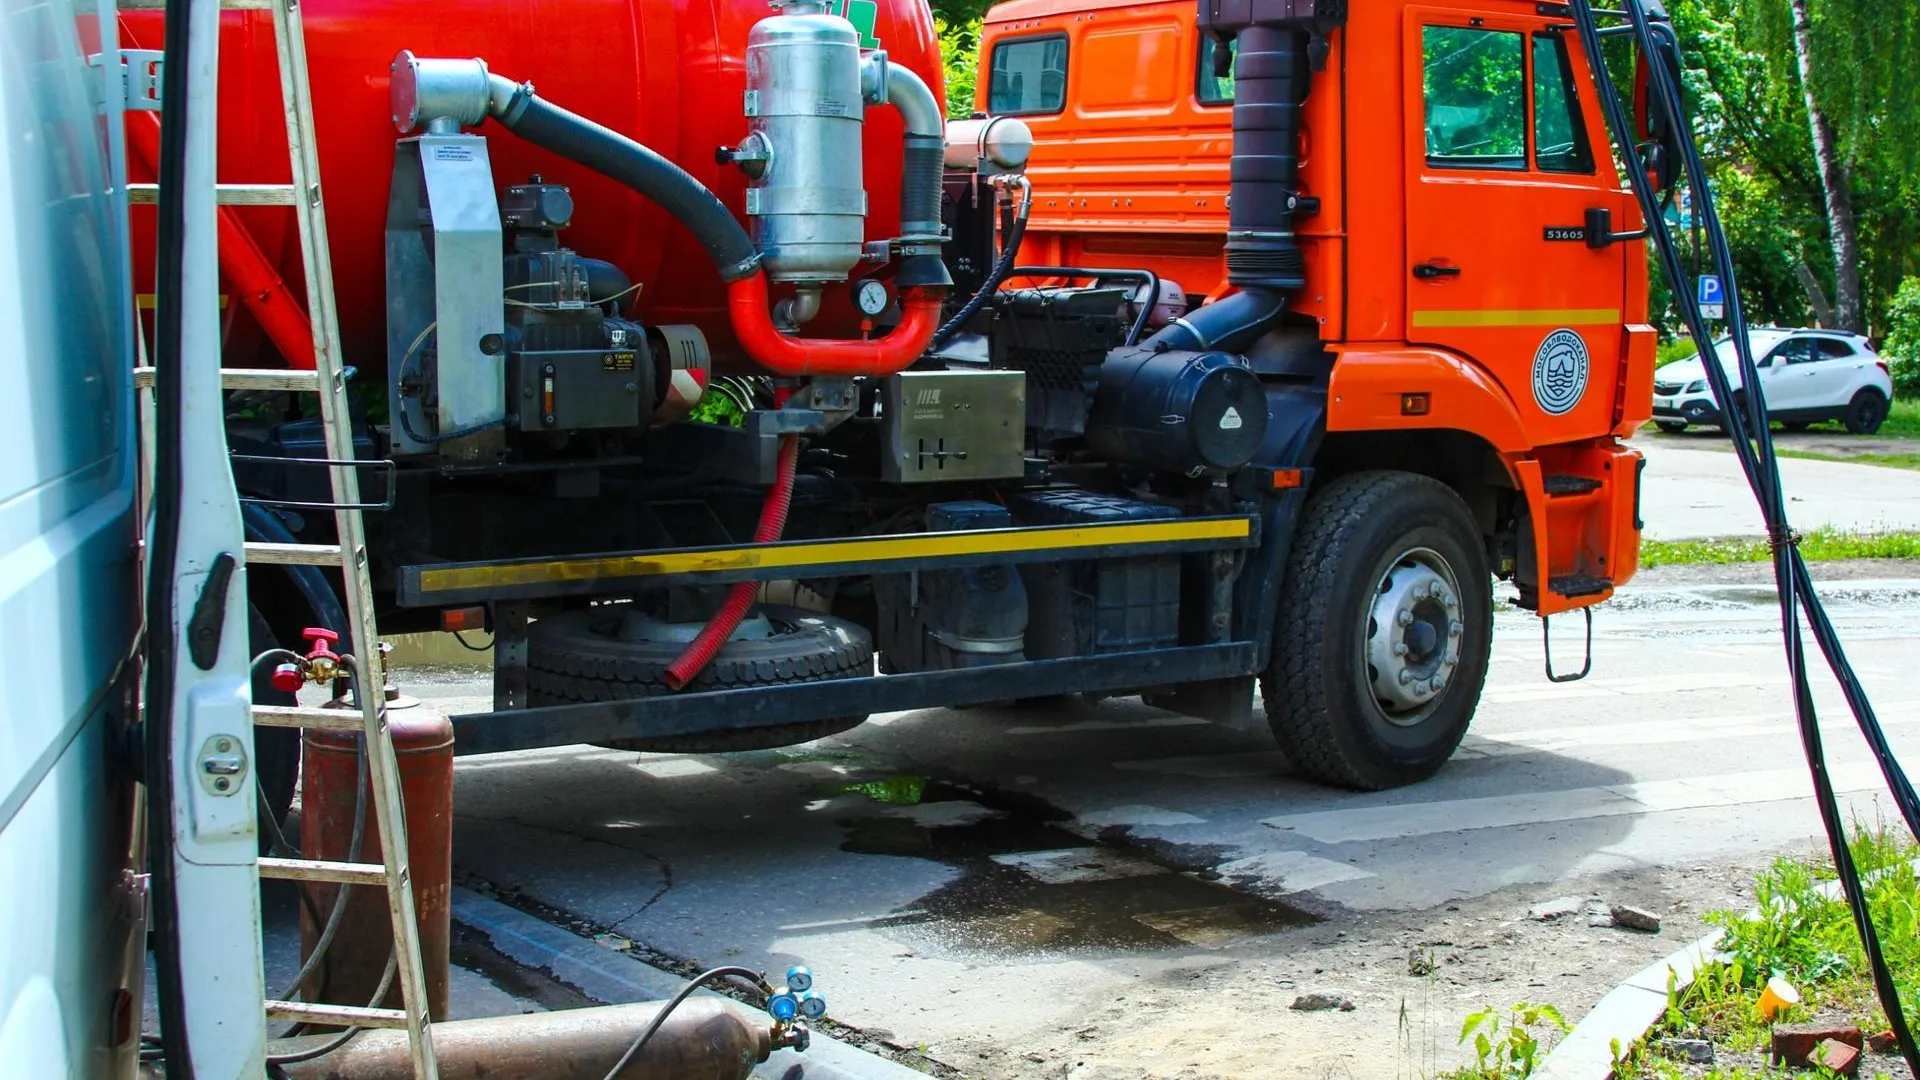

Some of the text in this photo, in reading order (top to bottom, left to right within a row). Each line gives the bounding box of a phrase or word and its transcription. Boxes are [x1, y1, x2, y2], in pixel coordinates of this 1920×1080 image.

[1547, 230, 1584, 239] 53605
[1704, 278, 1718, 300] P
[1535, 334, 1586, 380] МОСОБЛВОДОКАНАЛ
